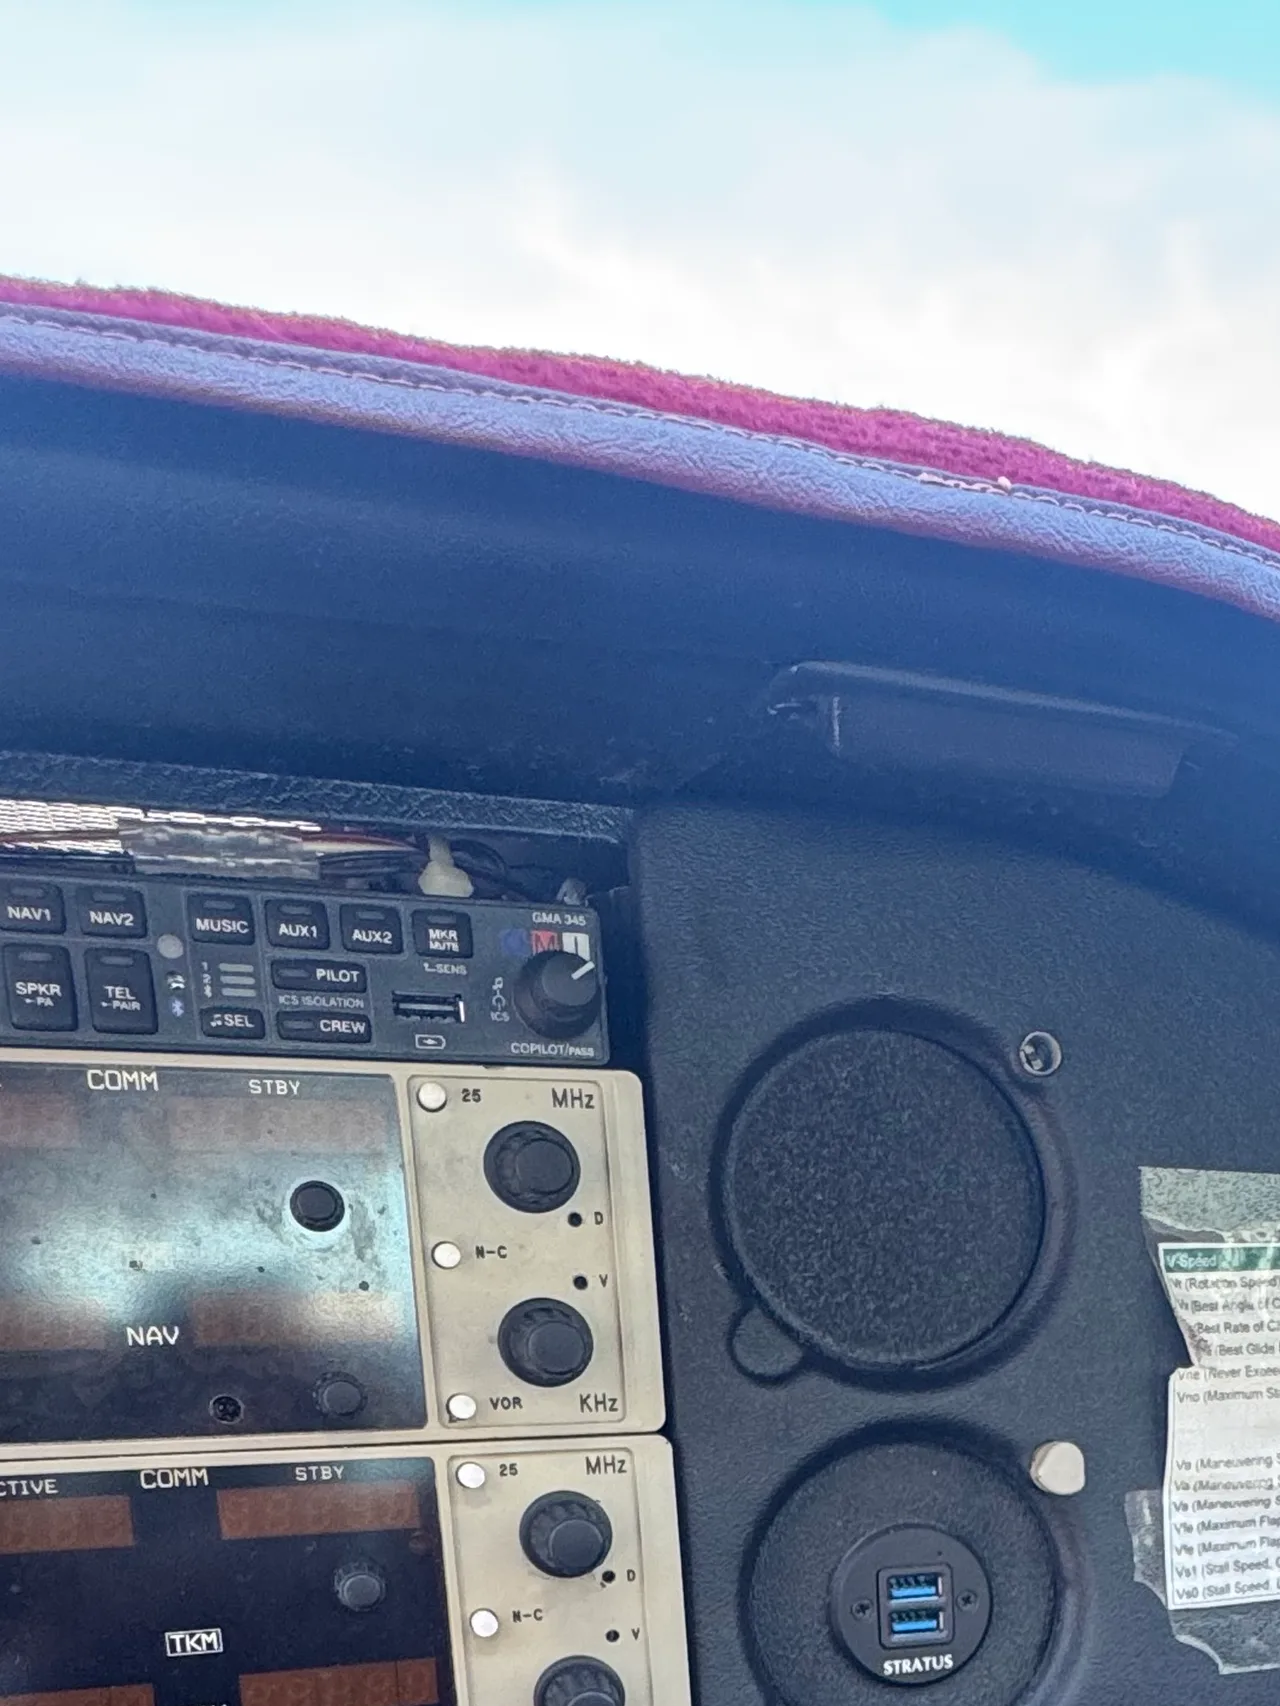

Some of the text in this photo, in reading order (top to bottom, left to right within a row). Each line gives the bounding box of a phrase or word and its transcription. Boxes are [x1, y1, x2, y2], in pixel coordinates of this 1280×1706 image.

[7, 905, 51, 922] NAV1
[89, 910, 135, 927] NAV2
[532, 911, 561, 925] GMA
[196, 918, 250, 934] MUSIC
[279, 923, 318, 939] AUX1
[352, 929, 393, 945] AUX2
[428, 928, 458, 942] MKR
[315, 968, 360, 983] PILOT
[15, 981, 62, 998] SPKR
[105, 985, 136, 1001] TEL
[36, 996, 55, 1008] PA
[112, 999, 142, 1012] PAIR
[301, 994, 365, 1010] ISOLATION
[224, 1013, 255, 1028] SEL
[319, 1019, 367, 1034] CREW
[87, 1069, 159, 1092] COMM
[248, 1078, 301, 1096] STBY
[461, 1088, 482, 1103] 25
[551, 1087, 595, 1109] MHz
[126, 1326, 180, 1347] NAV
[489, 1396, 524, 1411] VOR
[579, 1393, 619, 1413] KHz
[294, 1465, 345, 1482] STBY
[498, 1463, 519, 1477] 25
[585, 1457, 628, 1475] MHz
[140, 1467, 209, 1490] COMM
[169, 1631, 220, 1652] TKM
[882, 1654, 954, 1676] STRATUS
